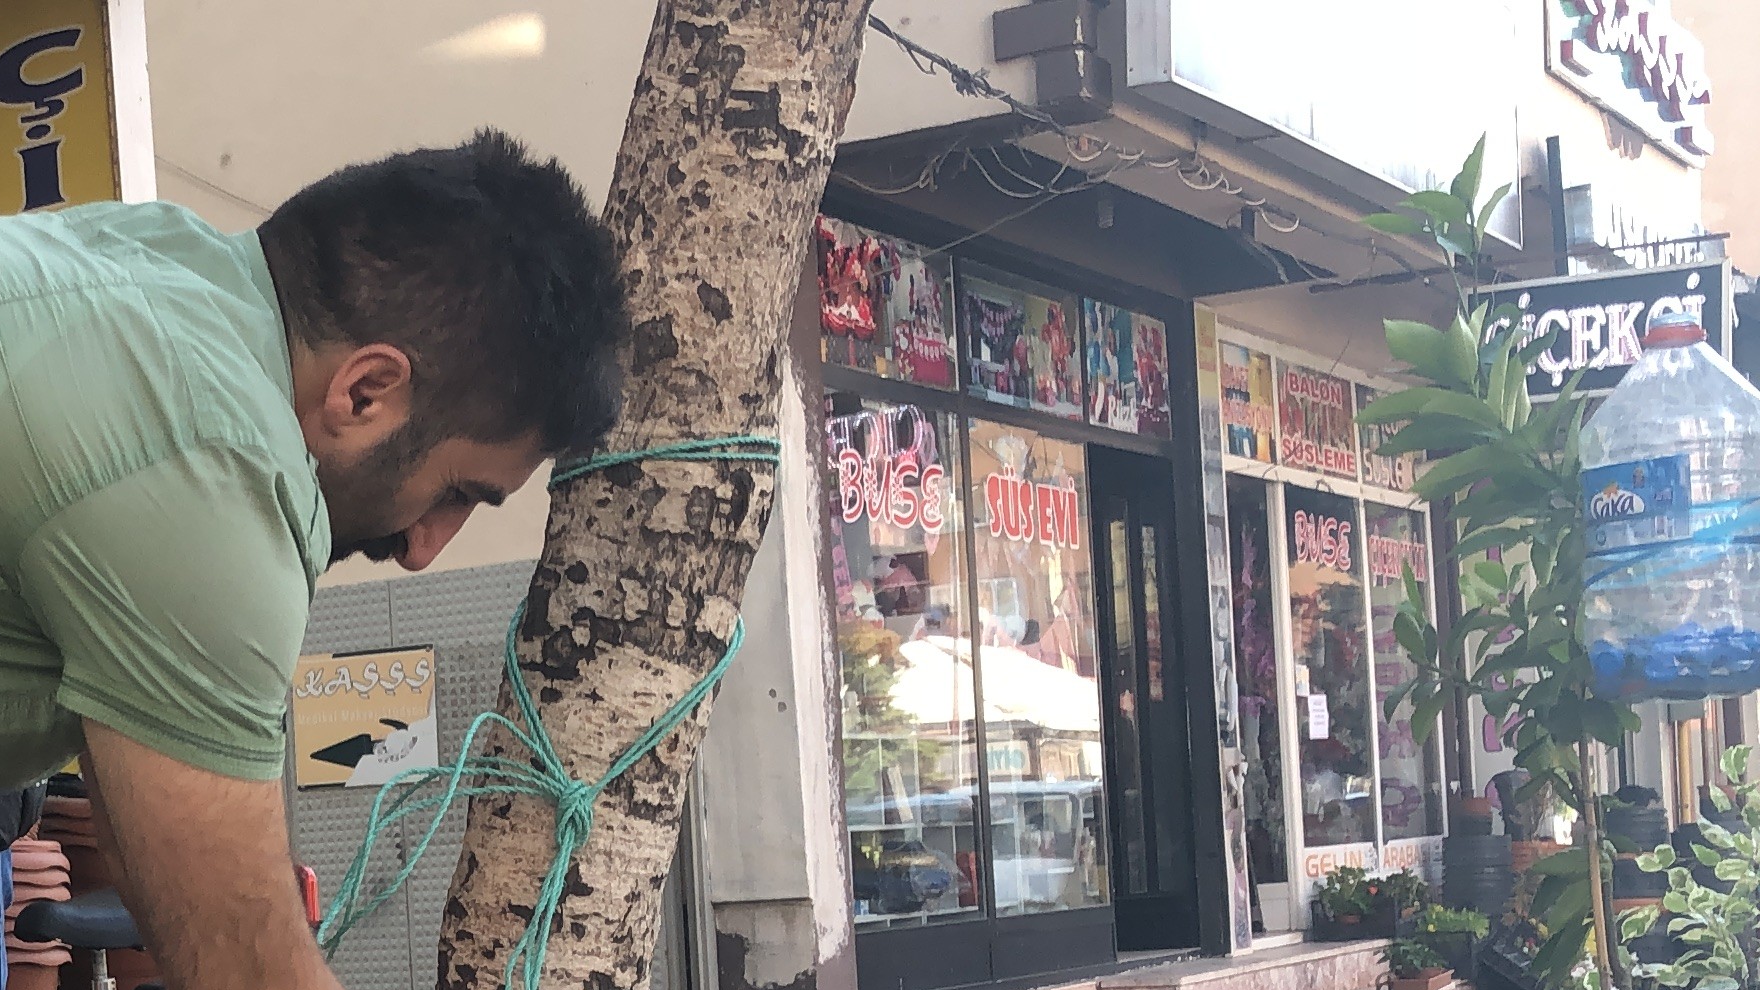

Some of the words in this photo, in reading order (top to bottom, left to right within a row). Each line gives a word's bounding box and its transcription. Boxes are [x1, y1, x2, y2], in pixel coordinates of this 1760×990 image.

[839, 448, 944, 534] BUSE
[985, 465, 1035, 544] SÜS
[1036, 475, 1080, 550] EVİ
[1294, 510, 1351, 571] BUSE
